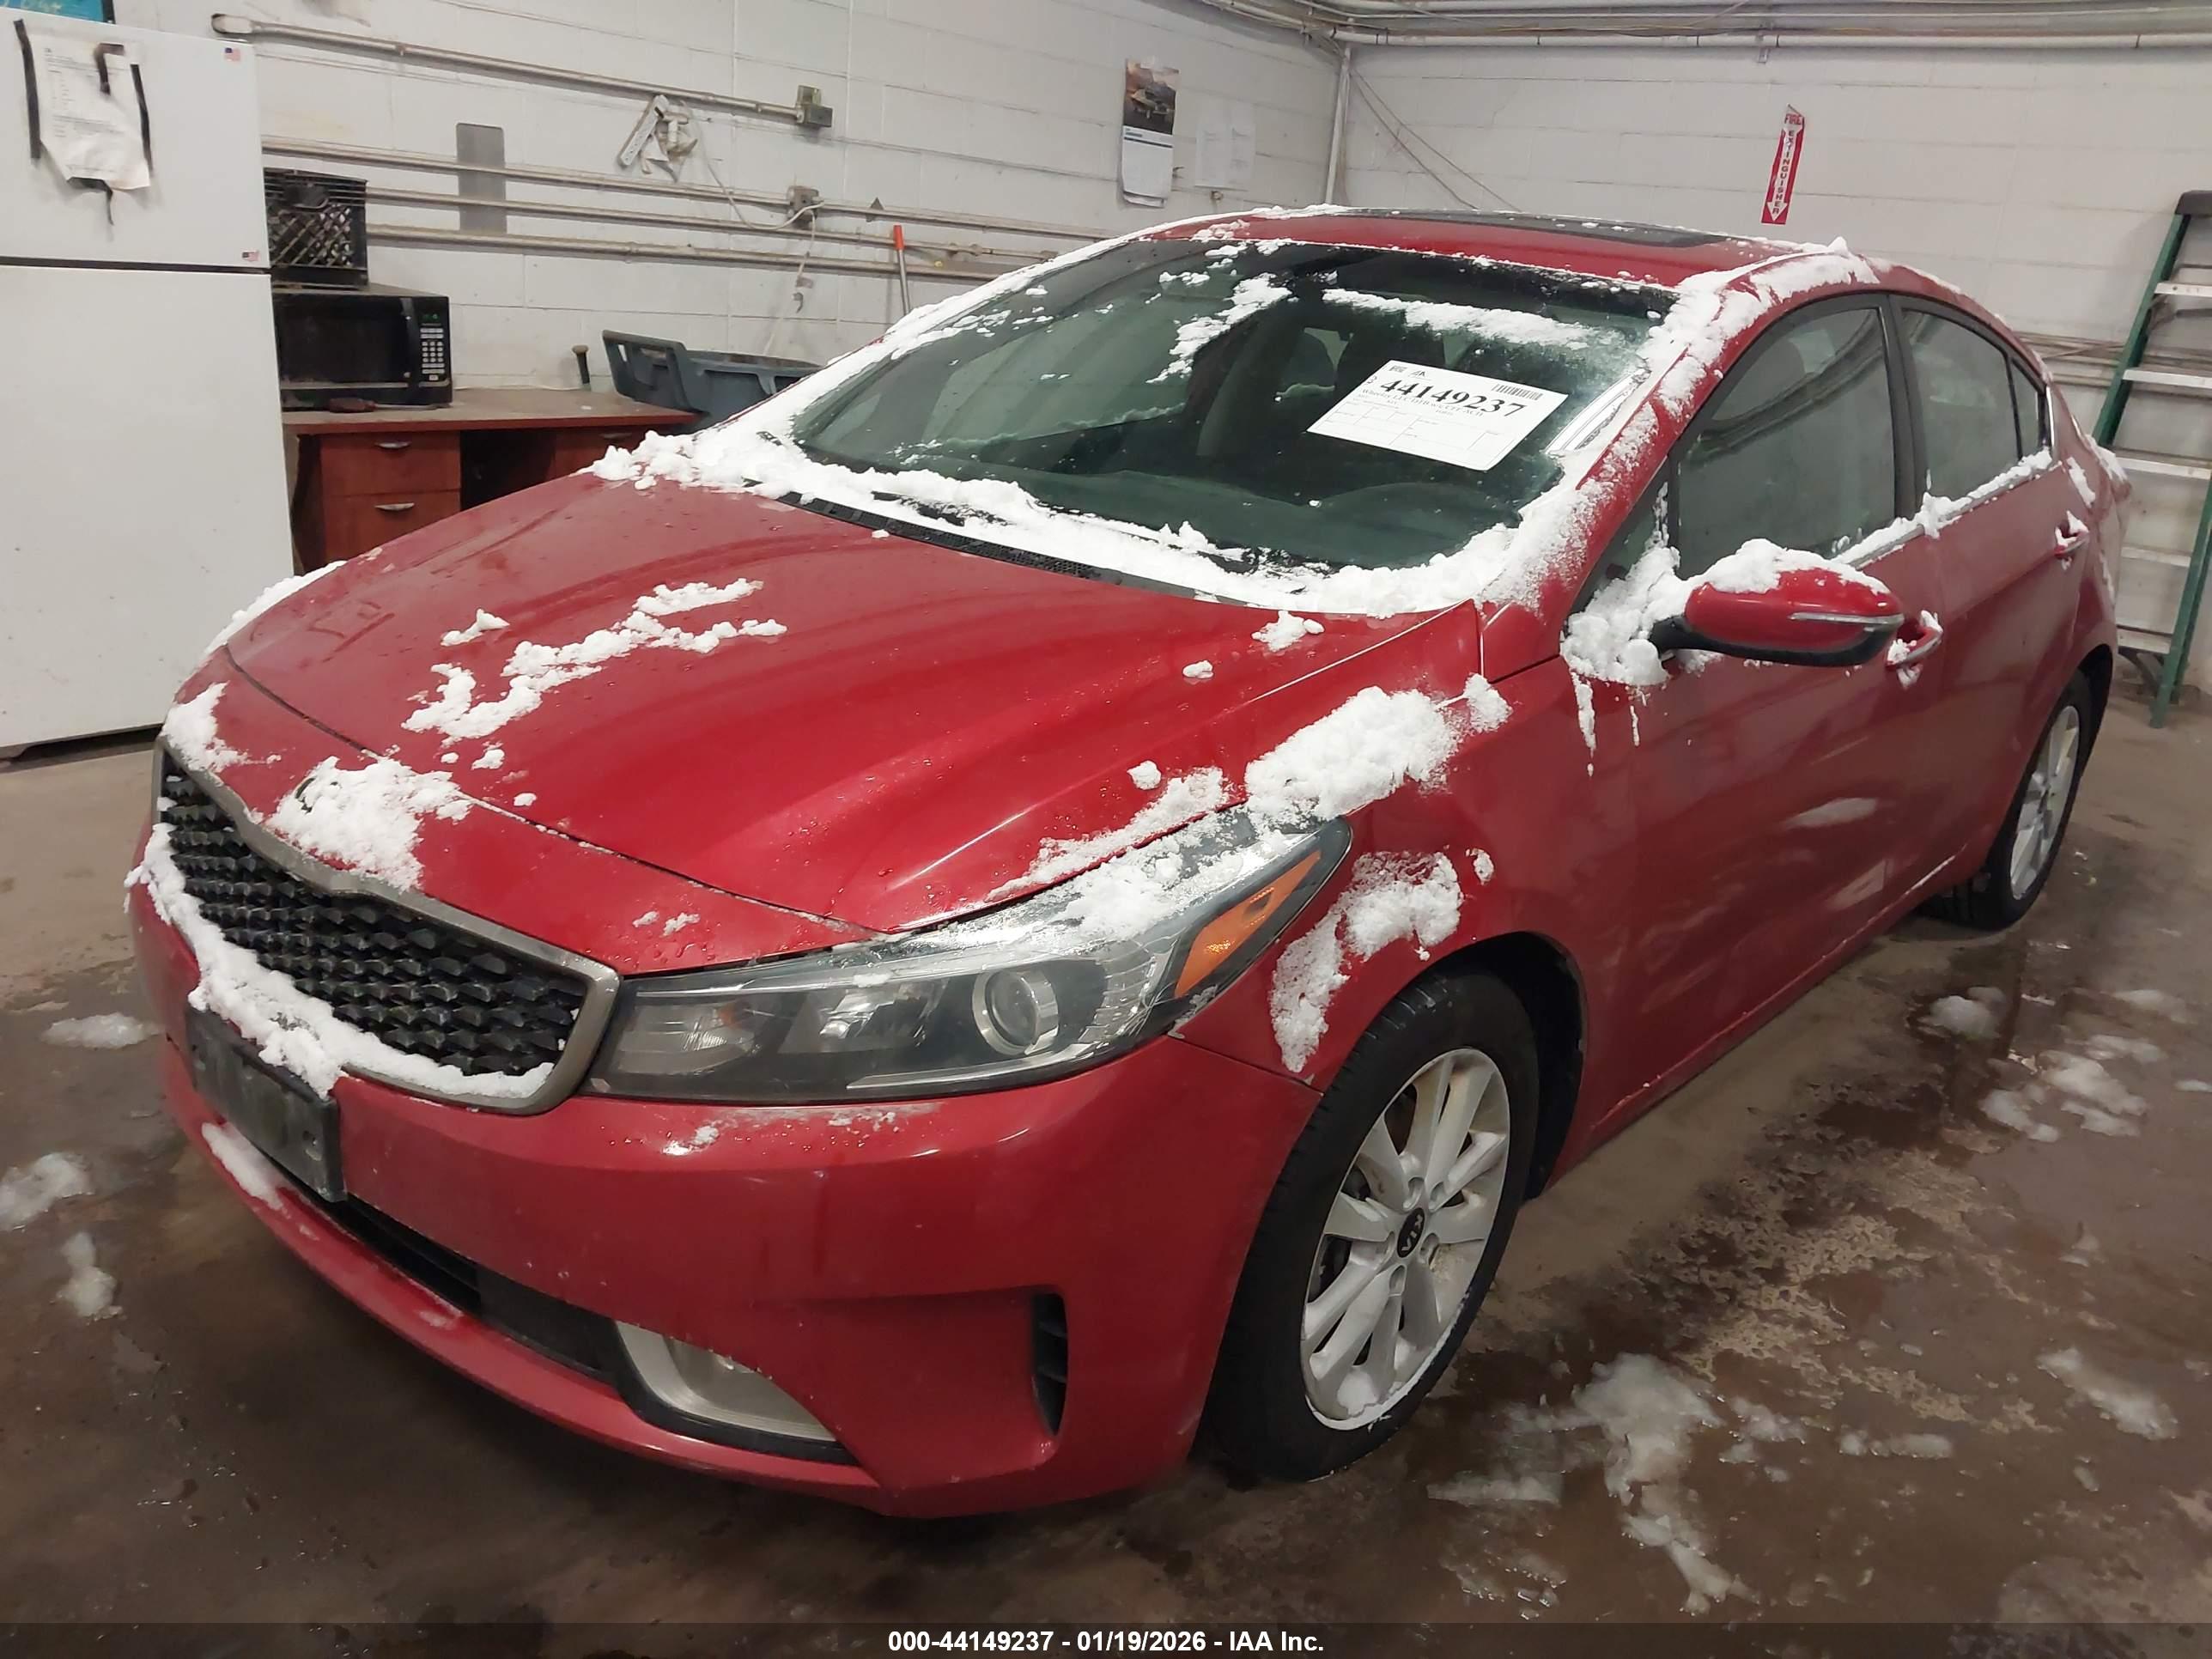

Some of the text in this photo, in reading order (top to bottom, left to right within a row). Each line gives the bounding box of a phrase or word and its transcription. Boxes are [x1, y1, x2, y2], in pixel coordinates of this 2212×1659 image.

[1784, 113, 1802, 125] FIRE
[1772, 130, 1794, 214] EXTINGUISHER
[1380, 380, 1527, 417] 44149237
[1401, 1213, 1423, 1251] KIA
